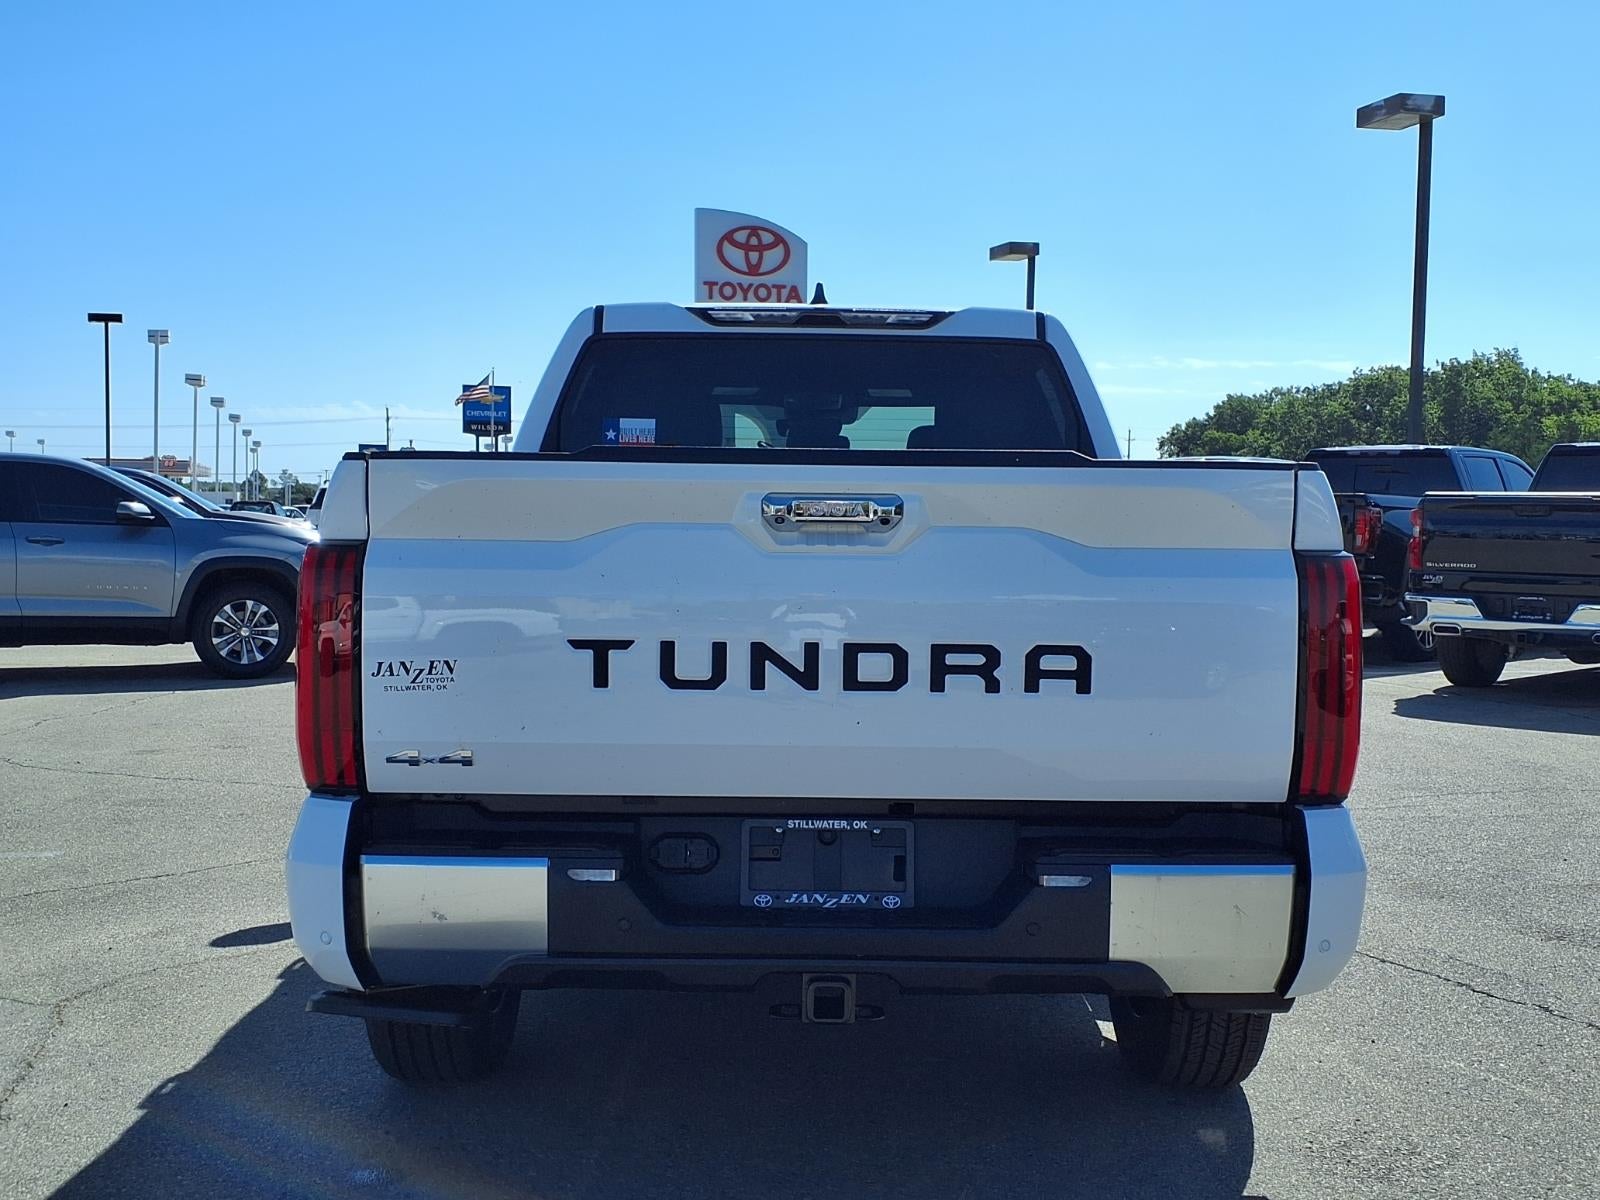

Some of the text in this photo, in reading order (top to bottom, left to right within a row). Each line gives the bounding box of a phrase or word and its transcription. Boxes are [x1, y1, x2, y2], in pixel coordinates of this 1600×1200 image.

[703, 281, 804, 303] TOYOTA
[619, 434, 656, 444] LIVES HERE
[802, 503, 865, 517] TOYOTA
[371, 659, 457, 685] JANZEN
[566, 639, 1092, 694] TUNDRA
[425, 676, 455, 684] TOYOTA
[787, 819, 868, 829] STILLWATER, OK
[785, 893, 871, 908] JANZEN
